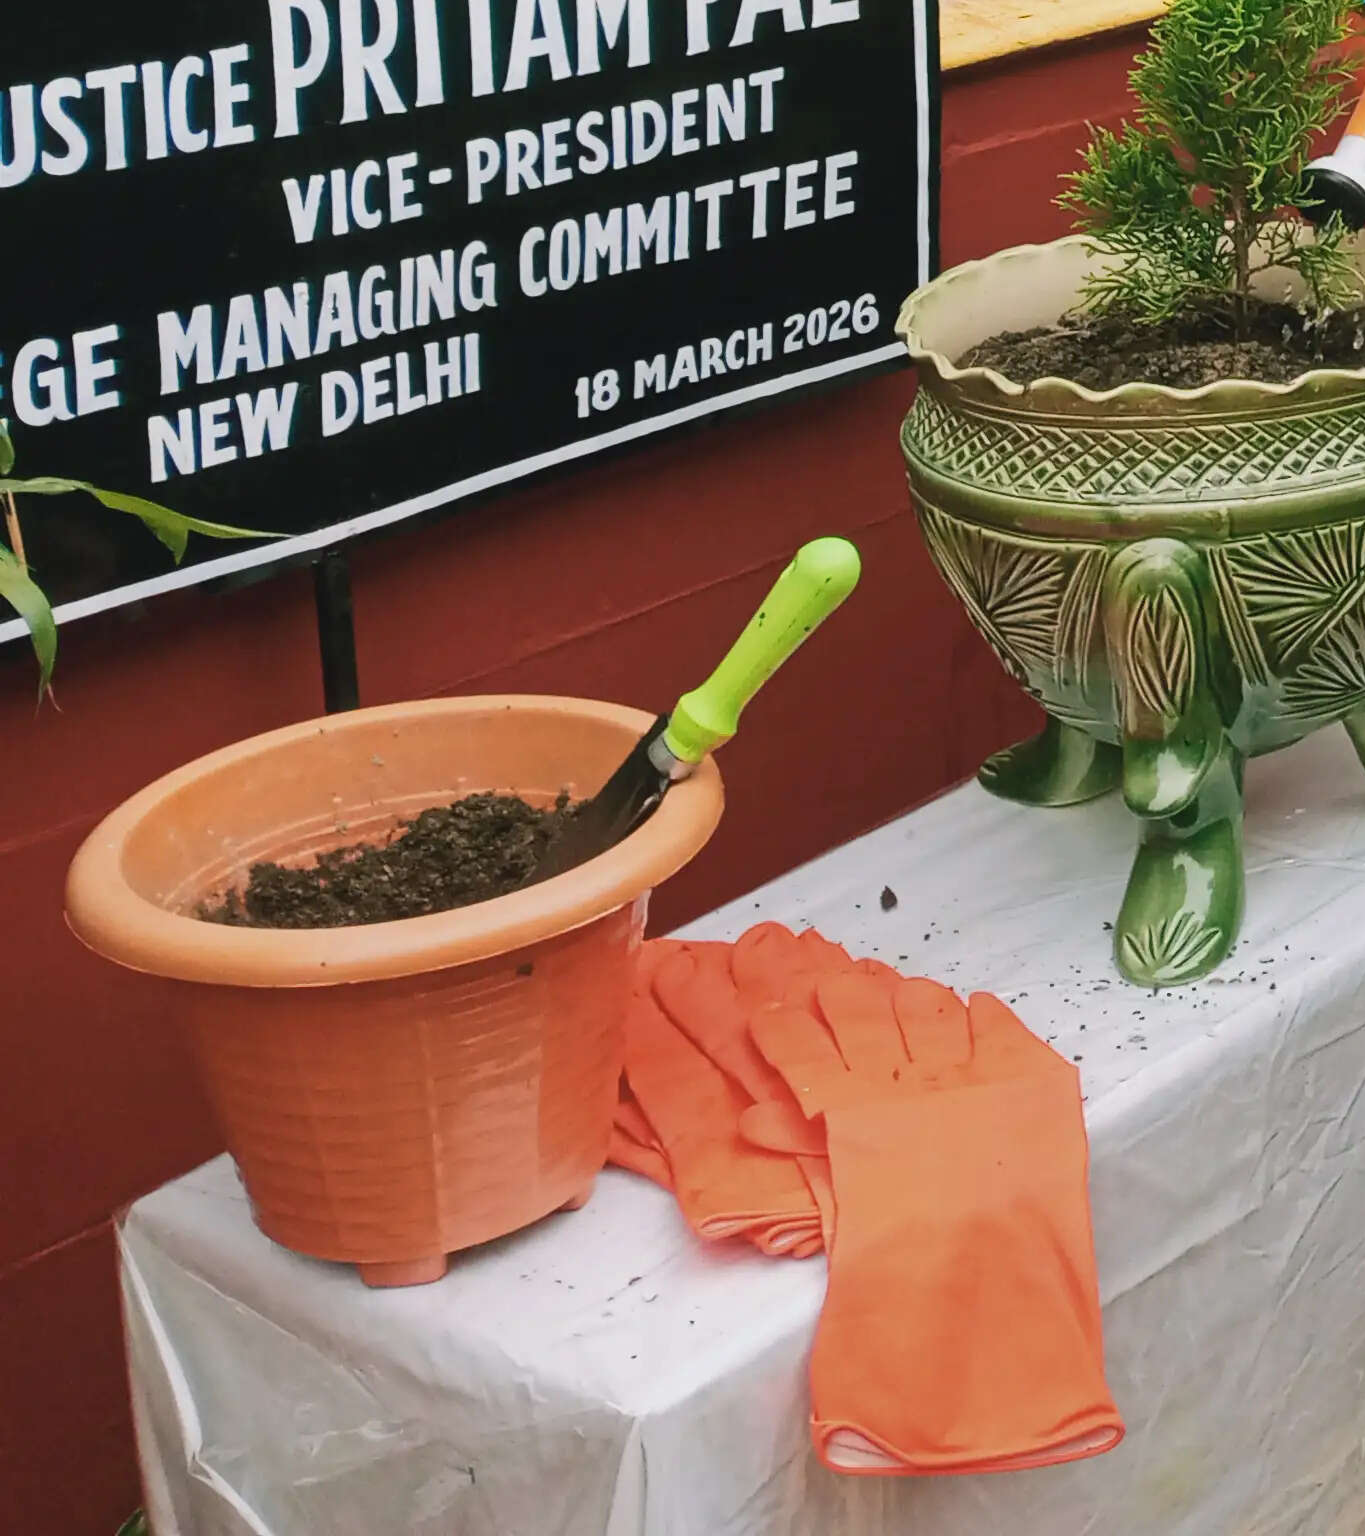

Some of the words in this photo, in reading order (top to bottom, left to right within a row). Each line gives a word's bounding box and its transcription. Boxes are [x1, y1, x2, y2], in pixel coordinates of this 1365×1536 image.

[282, 67, 785, 244] VICE-PRESIDENT
[0, 324, 120, 427] GE
[158, 241, 498, 396] MANAGING
[520, 151, 858, 296] COMMITTEE
[575, 369, 619, 418] 18
[634, 323, 773, 398] MARCH
[783, 294, 880, 354] 2026
[148, 371, 298, 482] NEW
[322, 333, 481, 437] DELHI
